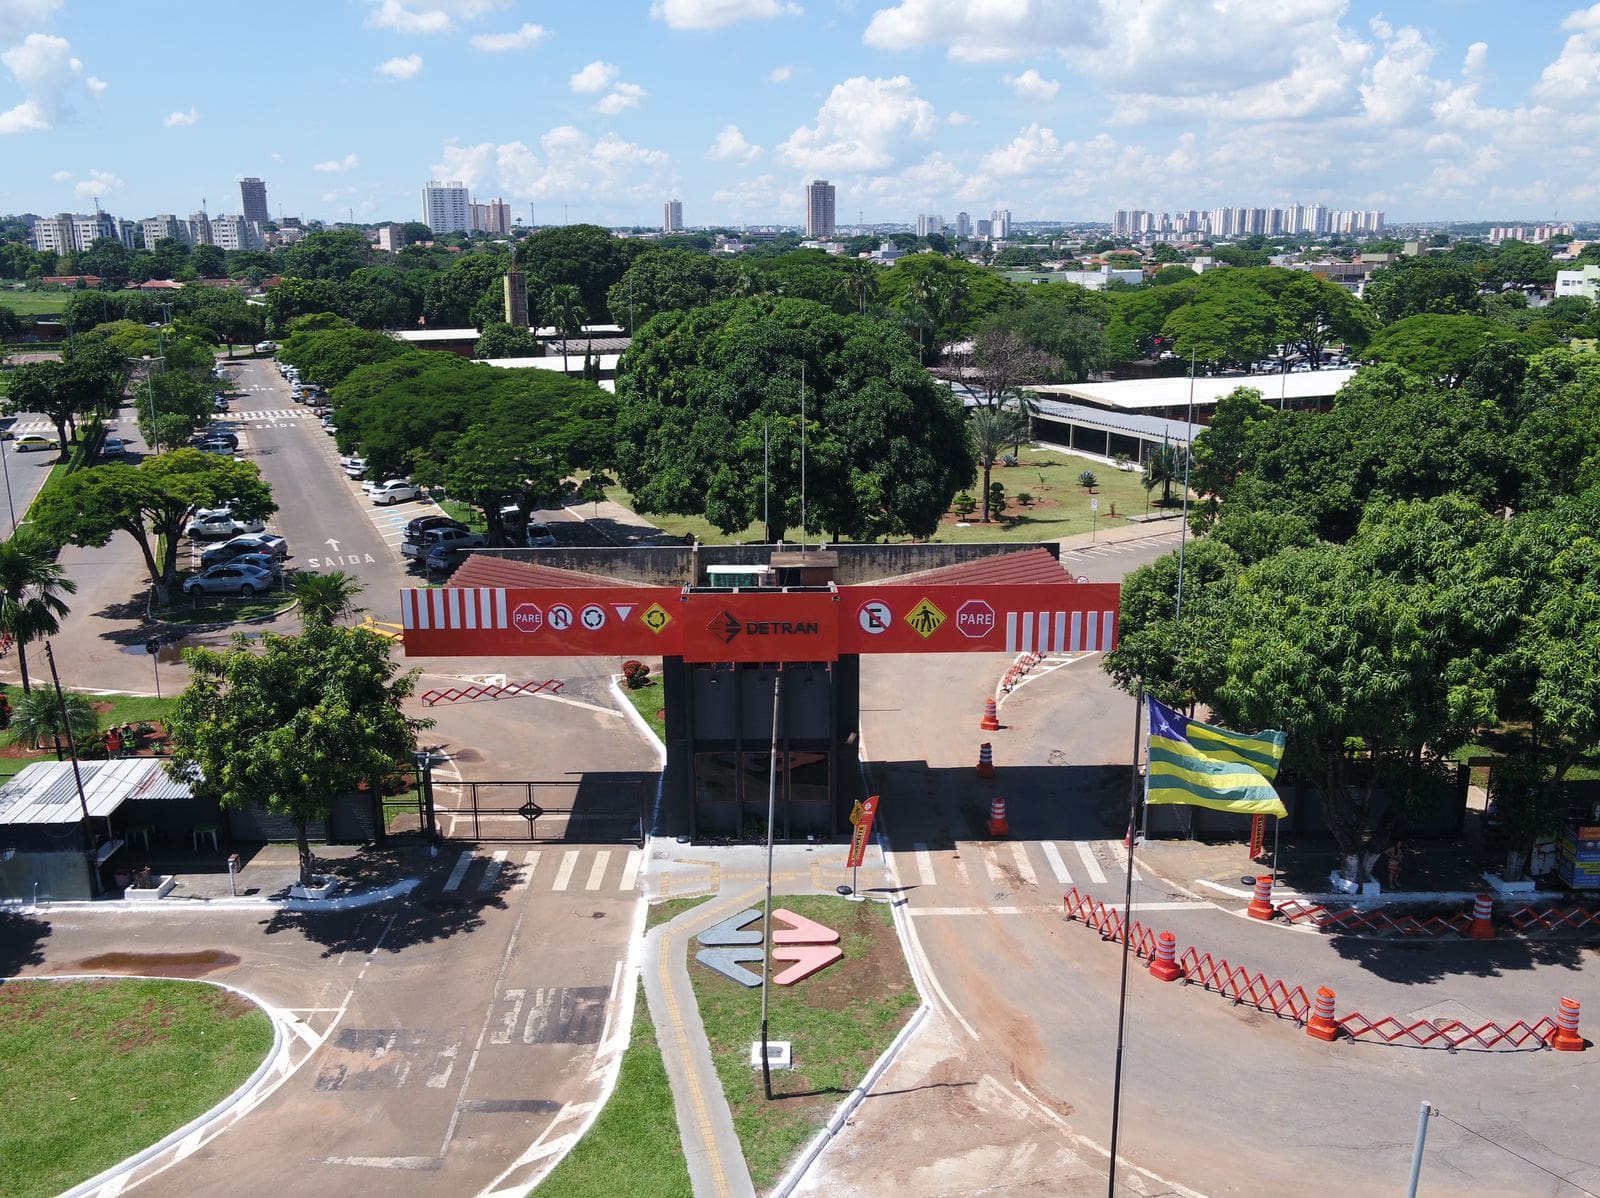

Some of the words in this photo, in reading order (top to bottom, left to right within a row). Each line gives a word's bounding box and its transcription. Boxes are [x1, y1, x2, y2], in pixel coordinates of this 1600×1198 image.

[308, 553, 376, 568] SAIDA
[515, 613, 540, 623] PARE
[960, 613, 992, 625] PARE
[746, 621, 819, 635] DETRAN
